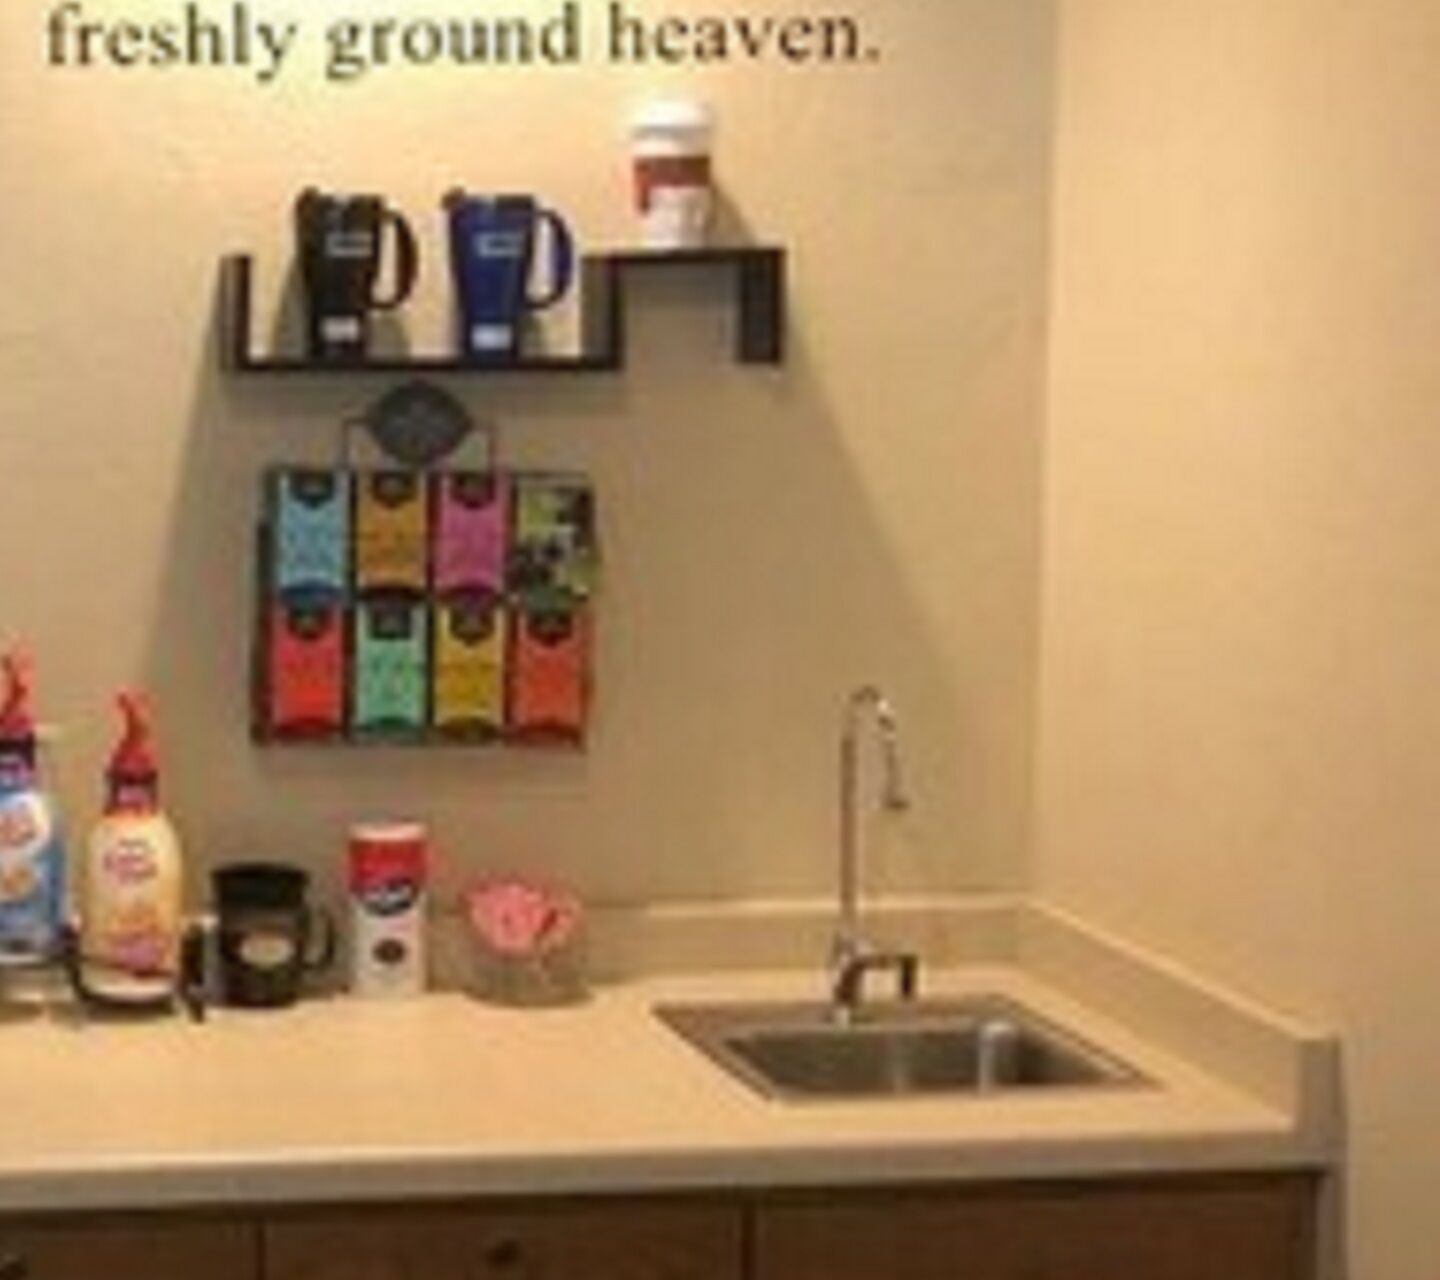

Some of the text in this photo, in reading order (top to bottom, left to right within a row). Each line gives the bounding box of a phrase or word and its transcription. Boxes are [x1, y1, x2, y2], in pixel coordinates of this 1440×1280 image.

[48, 1, 882, 82] freshly ground heaven.
